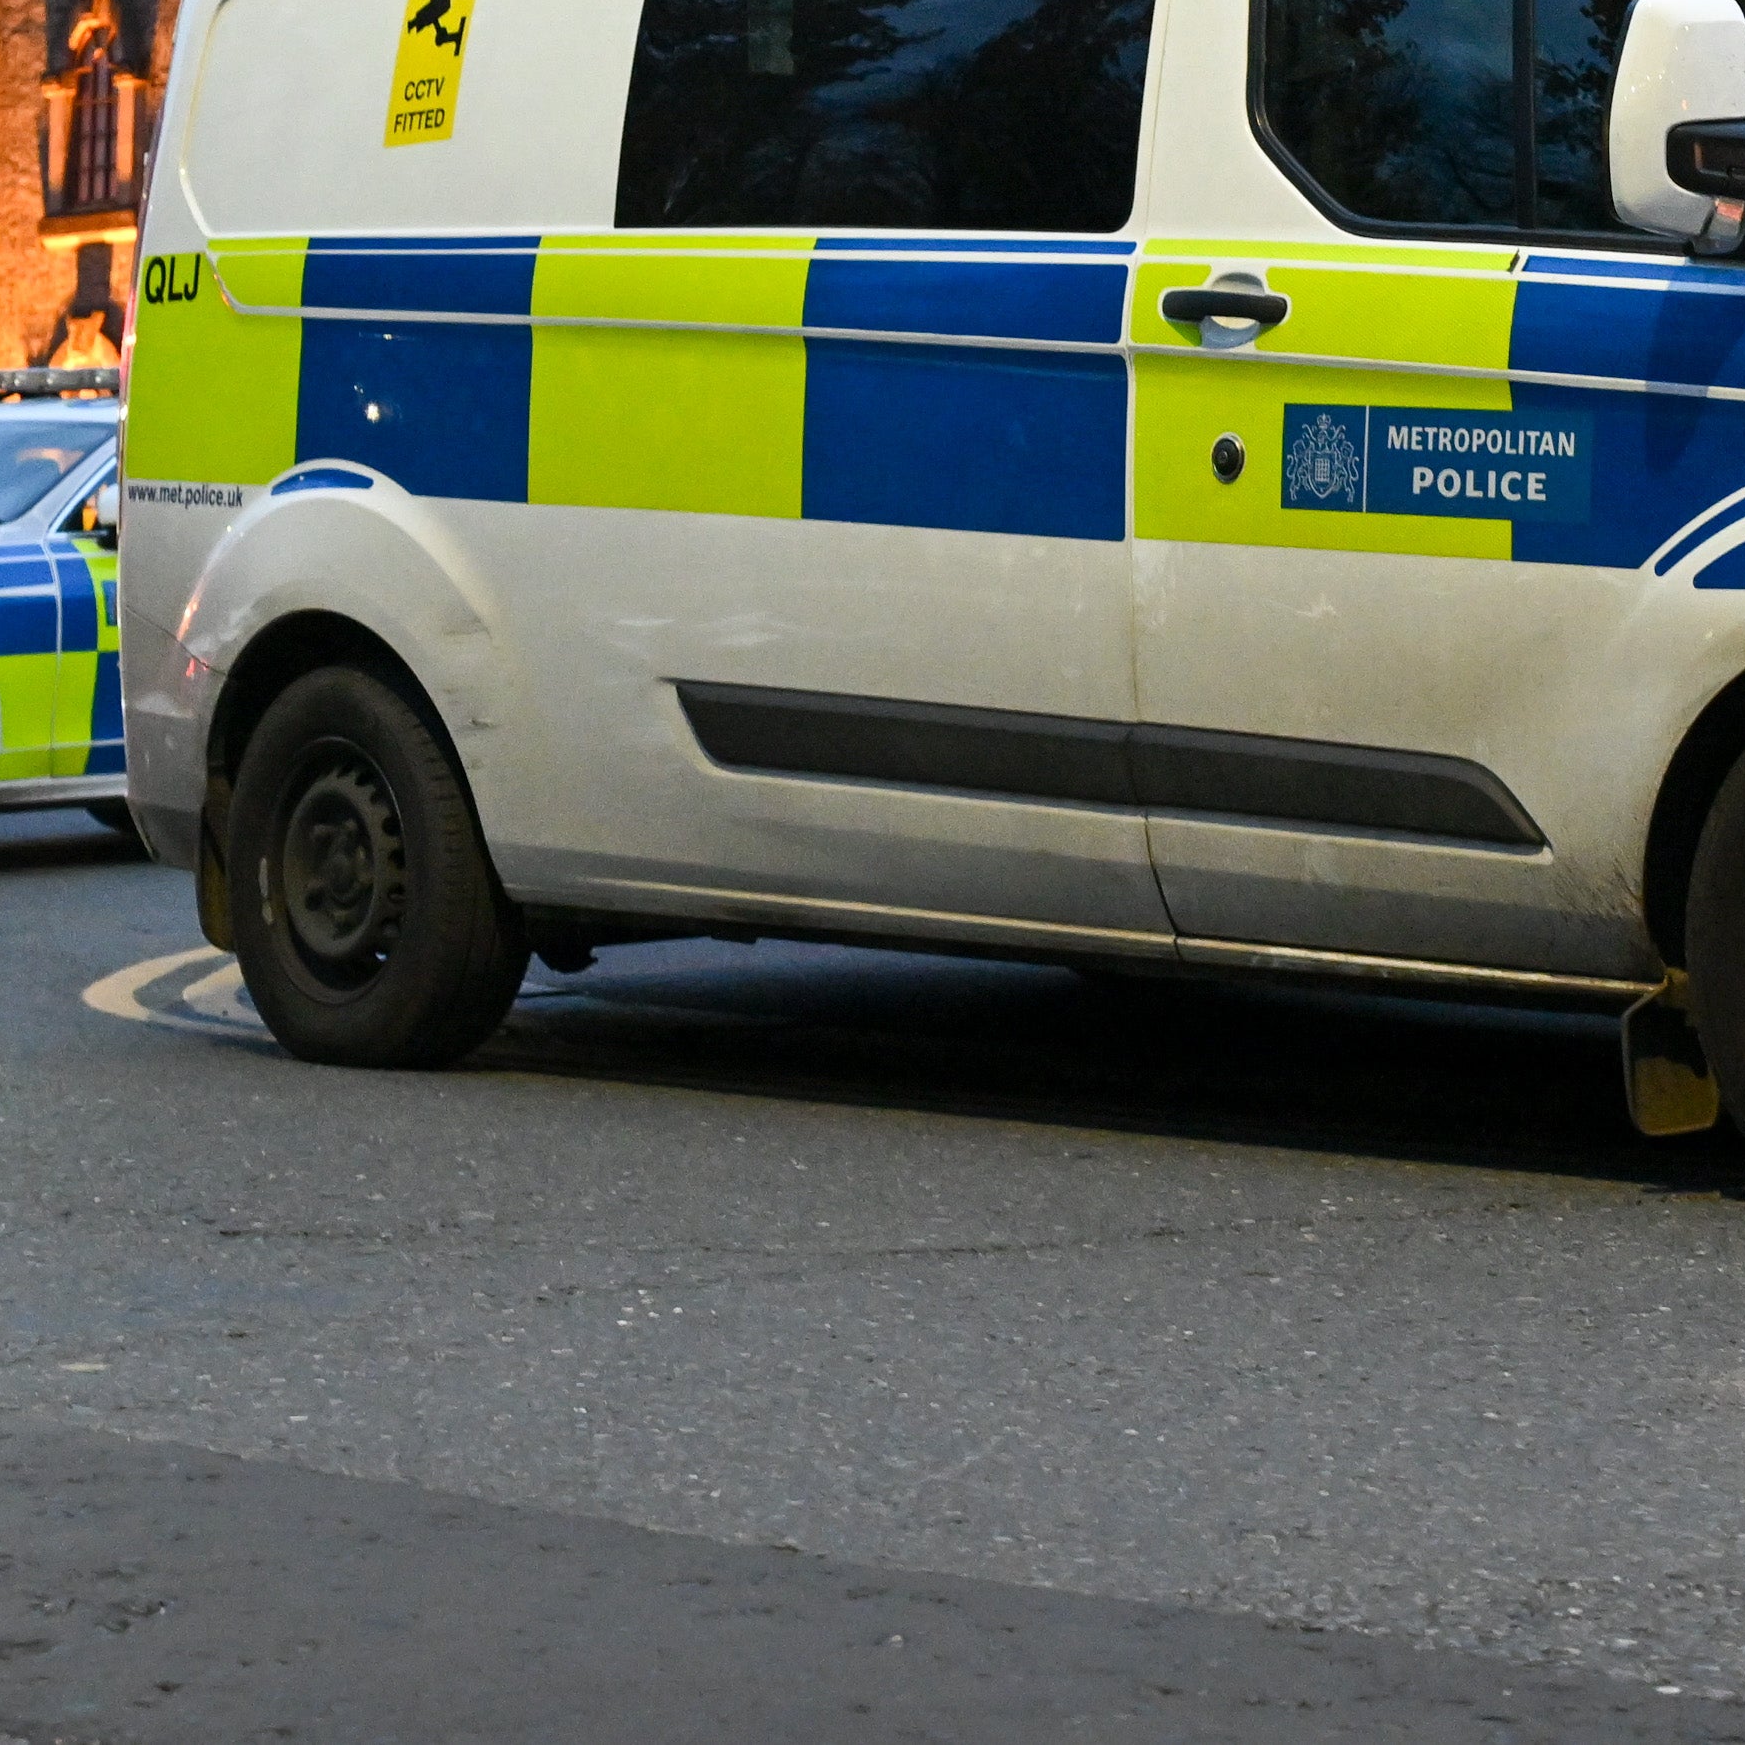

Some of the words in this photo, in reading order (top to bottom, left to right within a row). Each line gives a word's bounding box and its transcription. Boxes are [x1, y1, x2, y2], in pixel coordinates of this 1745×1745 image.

[404, 76, 444, 102] CCTV
[394, 107, 445, 134] FITTED
[145, 254, 200, 304] QLJ
[1387, 425, 1575, 457] METROPOLITAN
[128, 483, 243, 509] www.met.police.uk
[1412, 466, 1547, 501] POLICE
